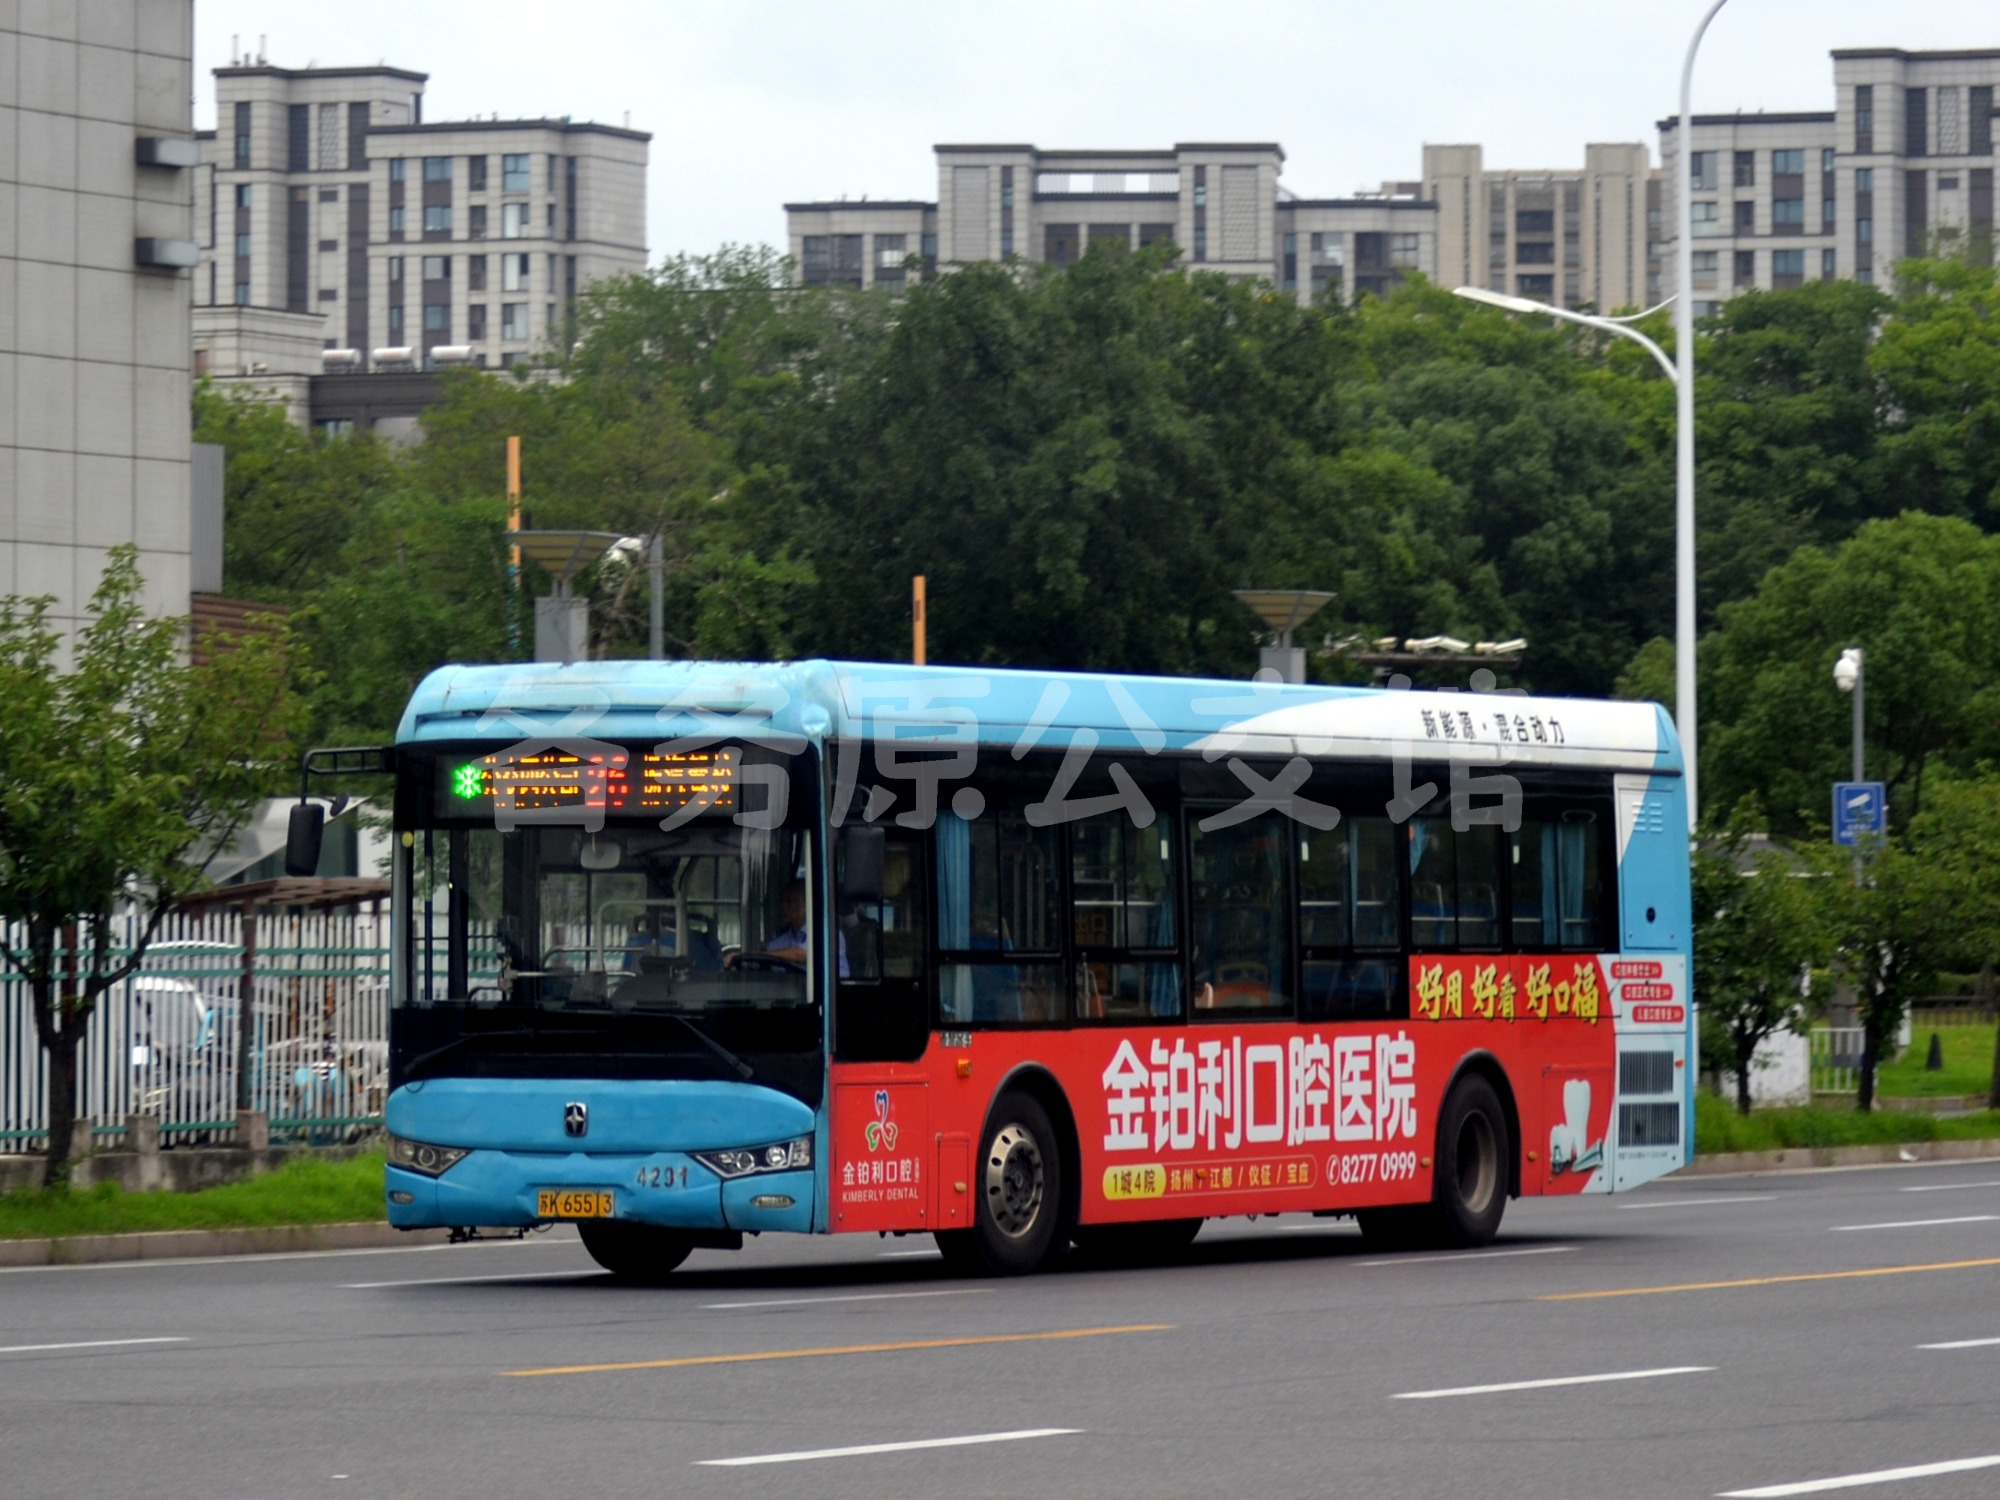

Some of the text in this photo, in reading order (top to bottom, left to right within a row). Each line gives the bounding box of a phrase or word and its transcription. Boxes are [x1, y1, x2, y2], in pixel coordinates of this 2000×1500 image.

[1102, 1030, 1417, 1155] 金铂利口腔医院
[842, 1158, 913, 1186] 金铂利口腔
[1340, 1150, 1417, 1185] 8277 0999
[842, 1186, 919, 1203] KIMBERLY DENTAL
